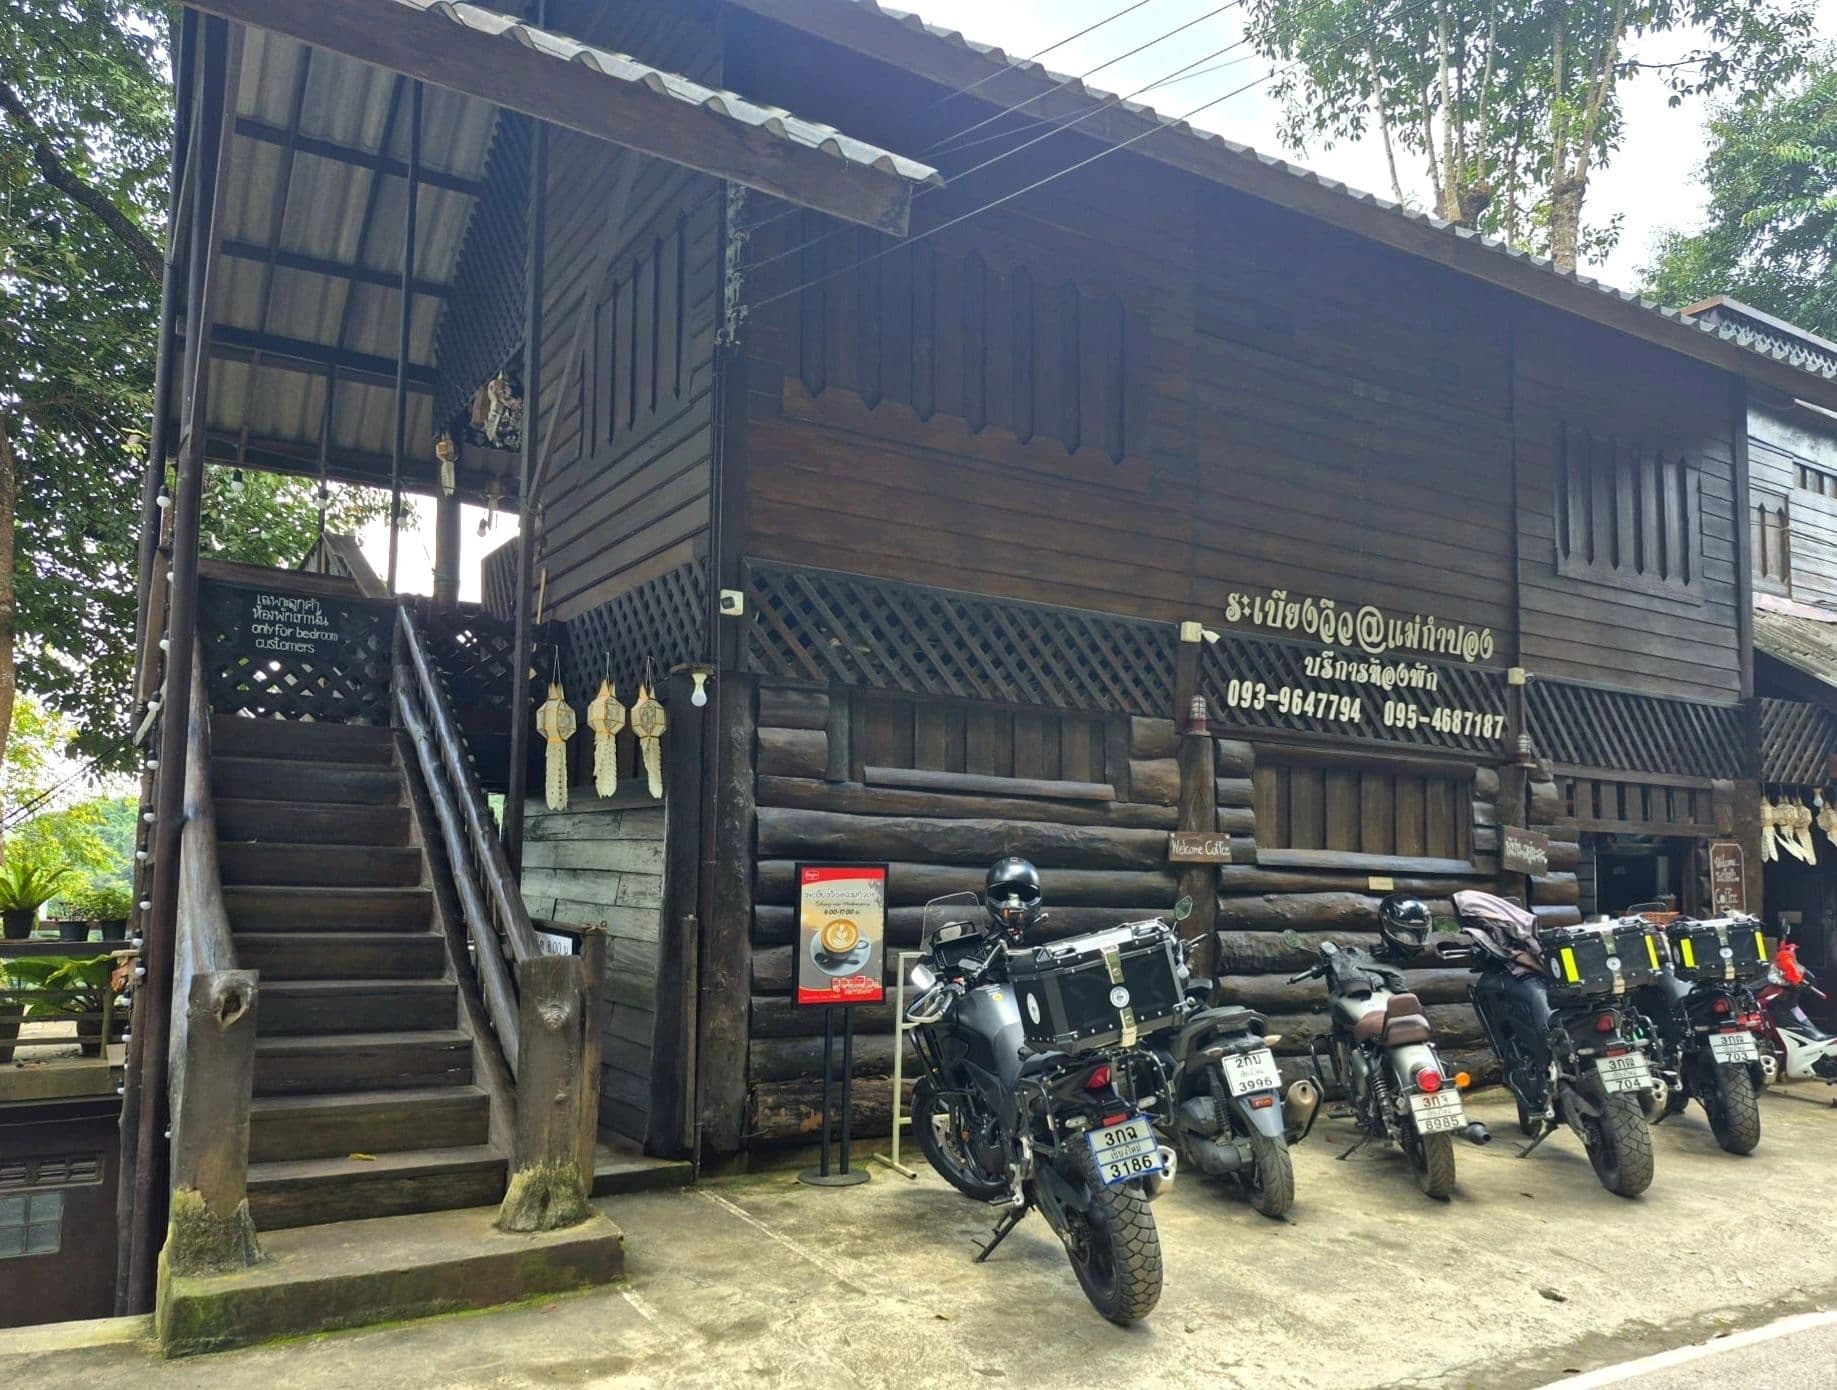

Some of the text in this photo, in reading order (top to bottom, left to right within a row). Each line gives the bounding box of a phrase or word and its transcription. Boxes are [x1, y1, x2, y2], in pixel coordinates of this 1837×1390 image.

[251, 623, 338, 641] only for bedroom
[1225, 589, 1495, 663] ระเบียงวิว@แม่กำปอง
[256, 637, 315, 654] customers
[1304, 650, 1438, 692] บริการห้องพัก
[1227, 679, 1504, 739] 093-9647794 095-4687187
[1171, 839, 1203, 855] Welcome
[1239, 1077, 1273, 1092] 3996
[1110, 1155, 1152, 1178] 3186
